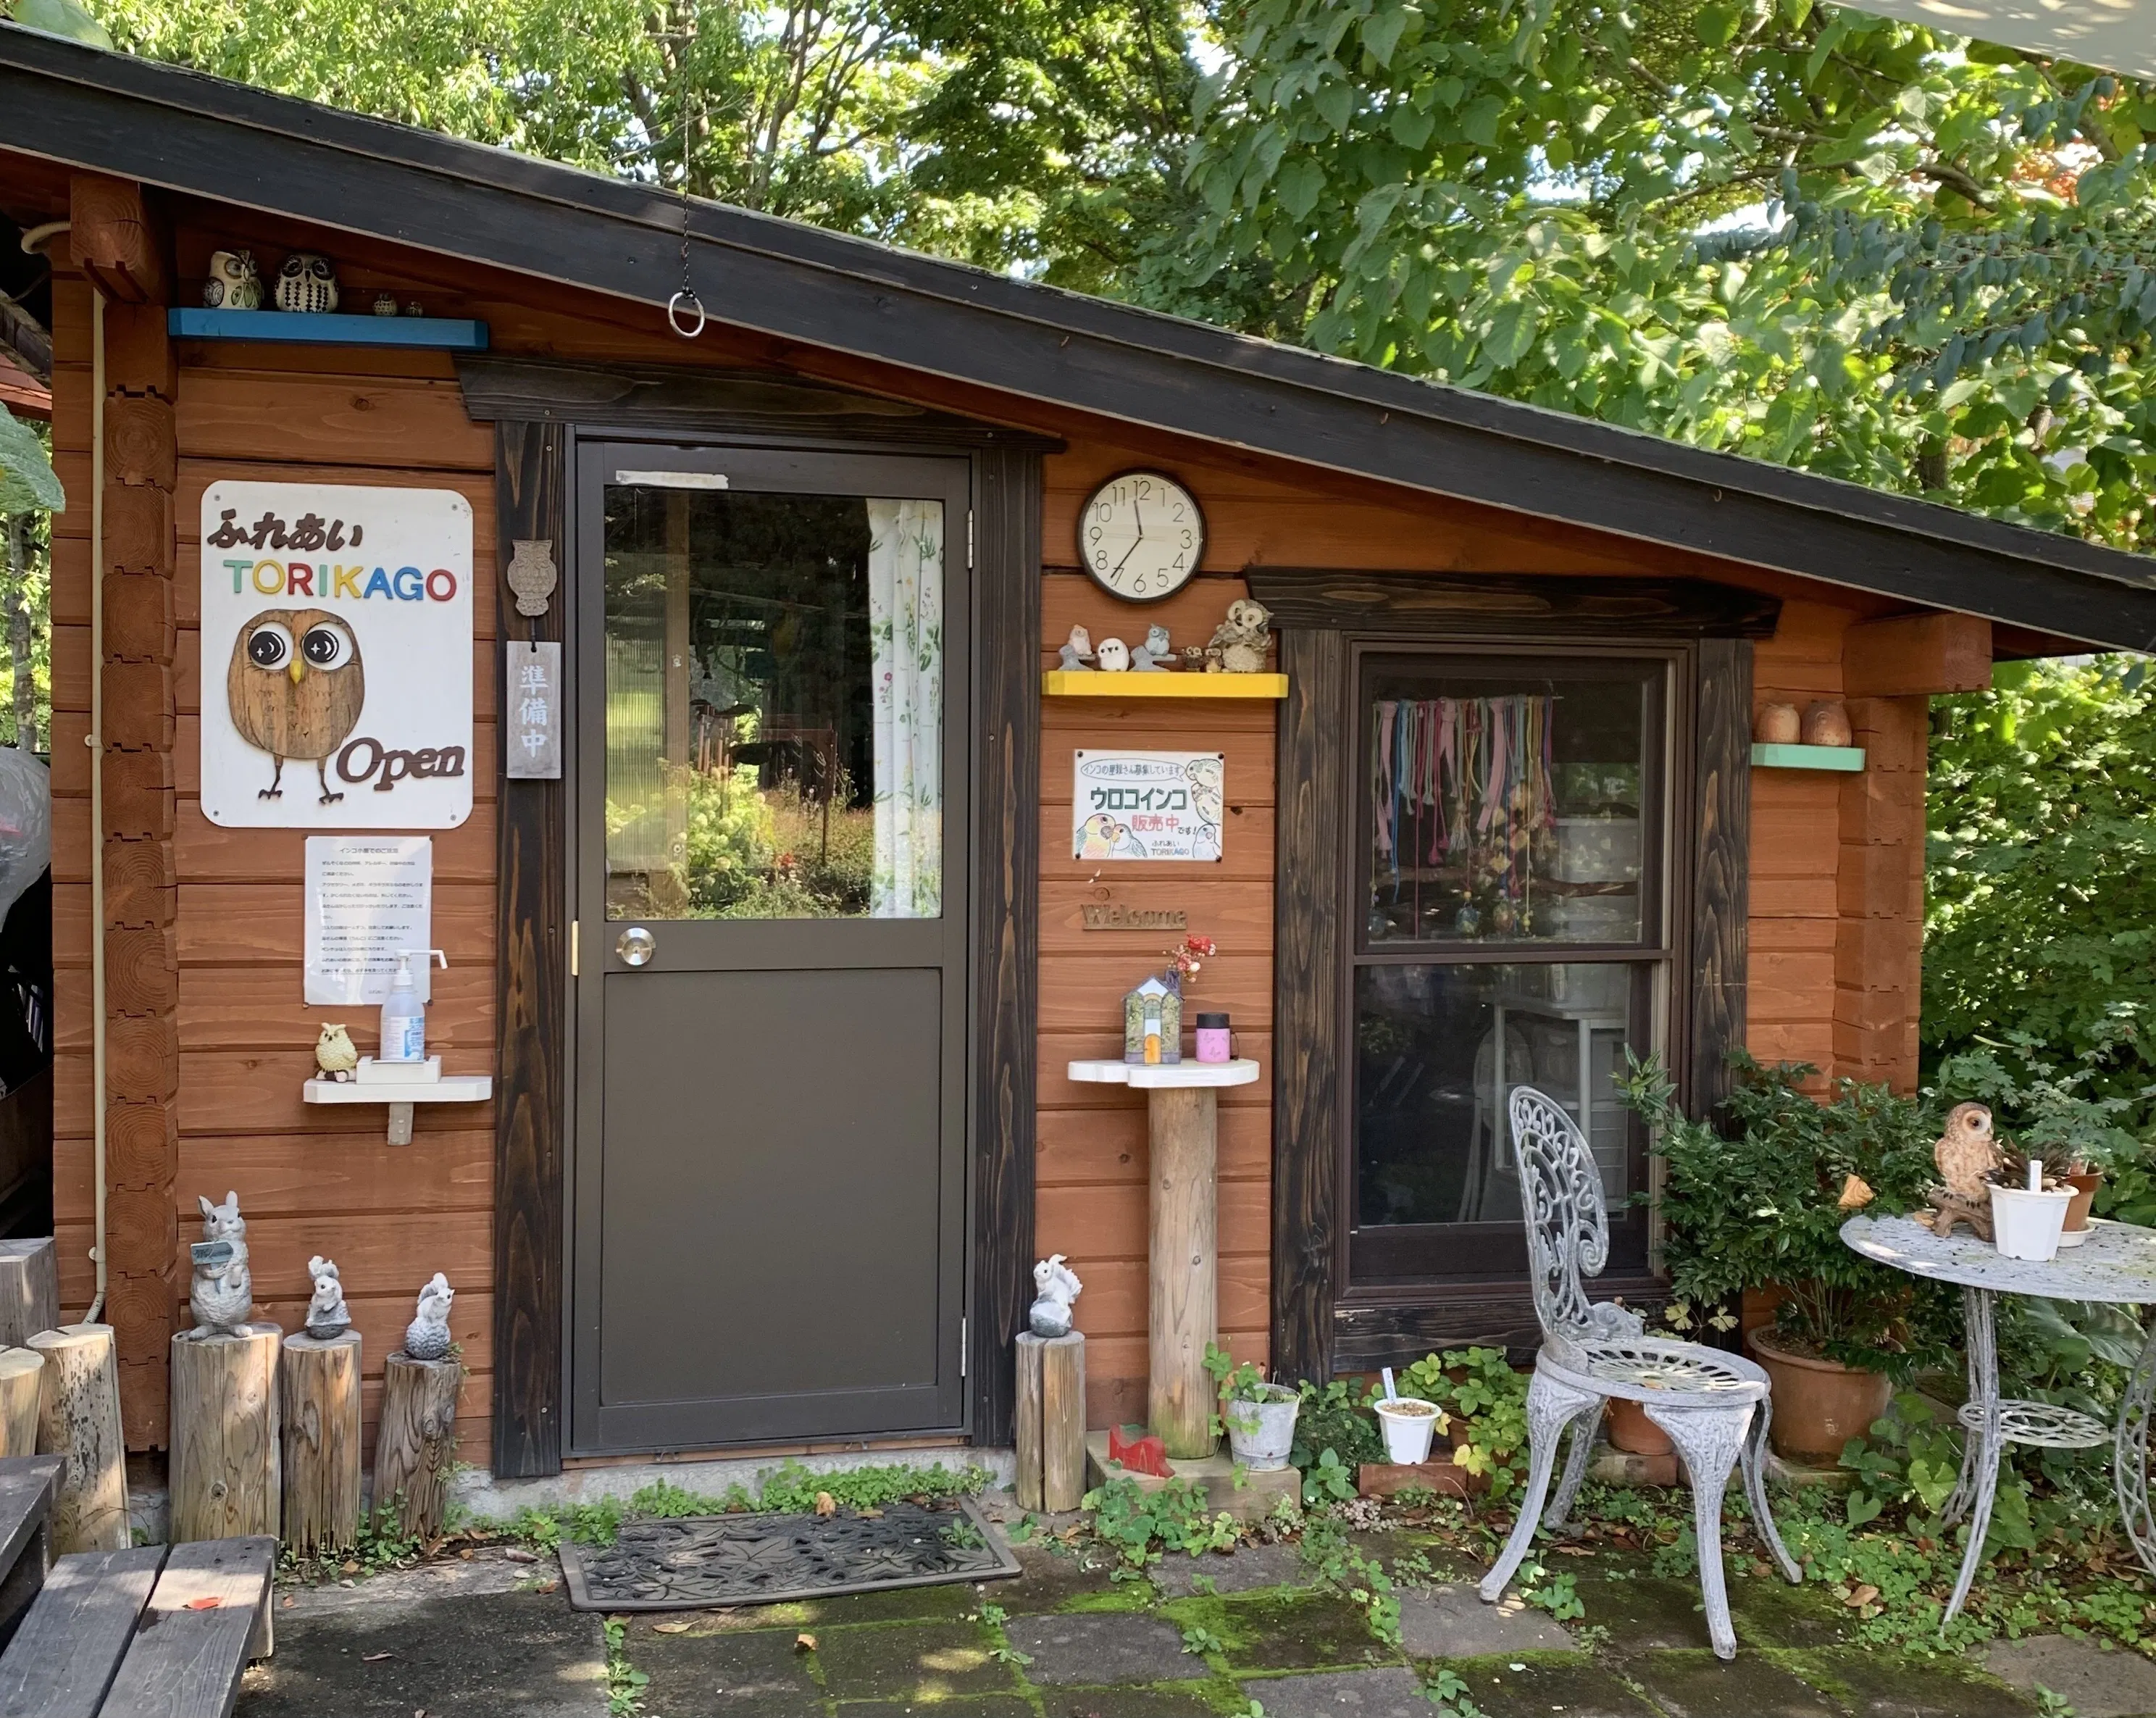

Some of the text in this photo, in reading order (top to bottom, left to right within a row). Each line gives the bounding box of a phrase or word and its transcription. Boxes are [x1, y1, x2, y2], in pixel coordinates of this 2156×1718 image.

[1113, 486, 1125, 506] 11
[1134, 480, 1150, 500] 12
[1160, 487, 1166, 507] 1
[1094, 502, 1112, 522] 10
[1172, 502, 1184, 522] 2
[207, 508, 364, 551] ふれあい
[1090, 526, 1103, 546] 9
[1180, 529, 1192, 549] 3
[1095, 550, 1108, 570] 8
[1171, 552, 1184, 572] 4
[223, 559, 457, 601] TORIKAGO
[1113, 567, 1124, 586] 7
[1134, 573, 1146, 593] 6
[1156, 568, 1169, 588] 5
[519, 664, 549, 759] 準備中
[336, 738, 465, 791] Open
[1091, 786, 1187, 810] ウロコインコ
[1132, 813, 1179, 833] 販売中
[1081, 904, 1187, 926] Welcome
